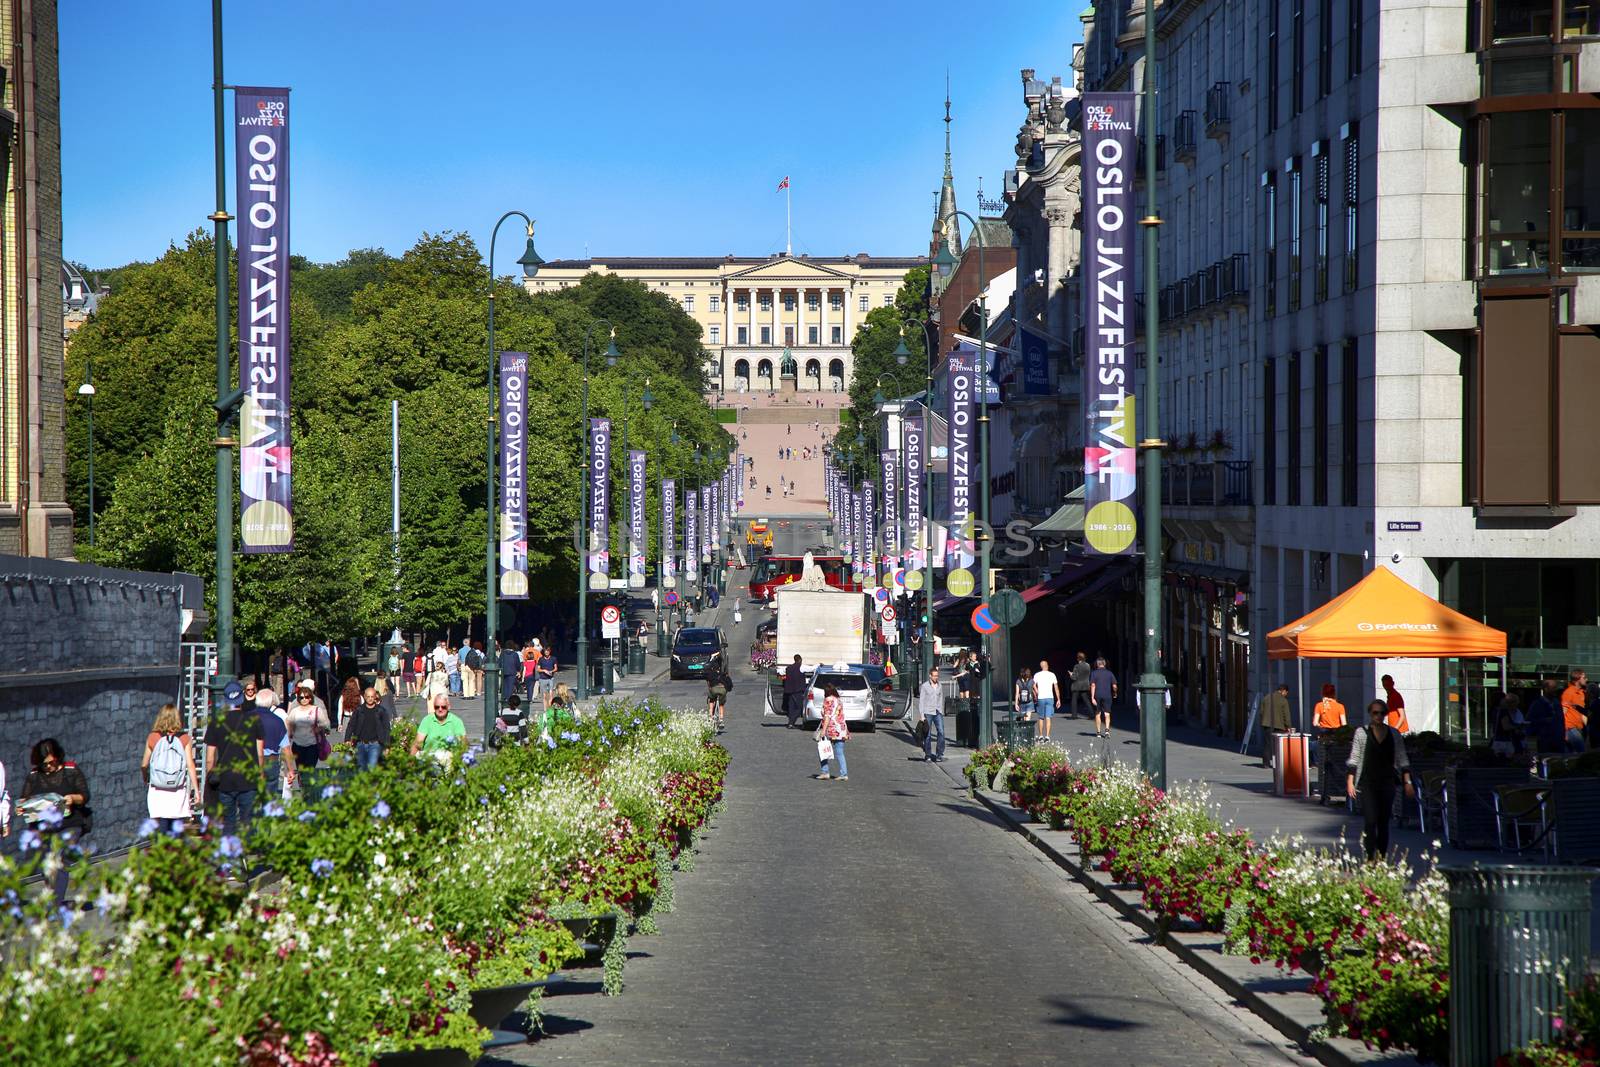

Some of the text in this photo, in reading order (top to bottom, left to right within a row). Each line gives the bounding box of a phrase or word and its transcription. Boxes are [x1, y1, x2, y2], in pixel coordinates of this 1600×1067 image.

[1087, 105, 1114, 115] OSLO
[1087, 114, 1112, 122] JAZZ
[1087, 122, 1132, 130] FESTIVAL
[1096, 138, 1125, 483] OSLO JAZZFESTIVAL
[908, 434, 919, 470] OSLO
[885, 463, 894, 492] OSLO
[954, 375, 968, 560] OSLO JAZZFESTIVAL
[885, 493, 894, 568] JAZZESTIVAL
[1113, 523, 1132, 531] 2016
